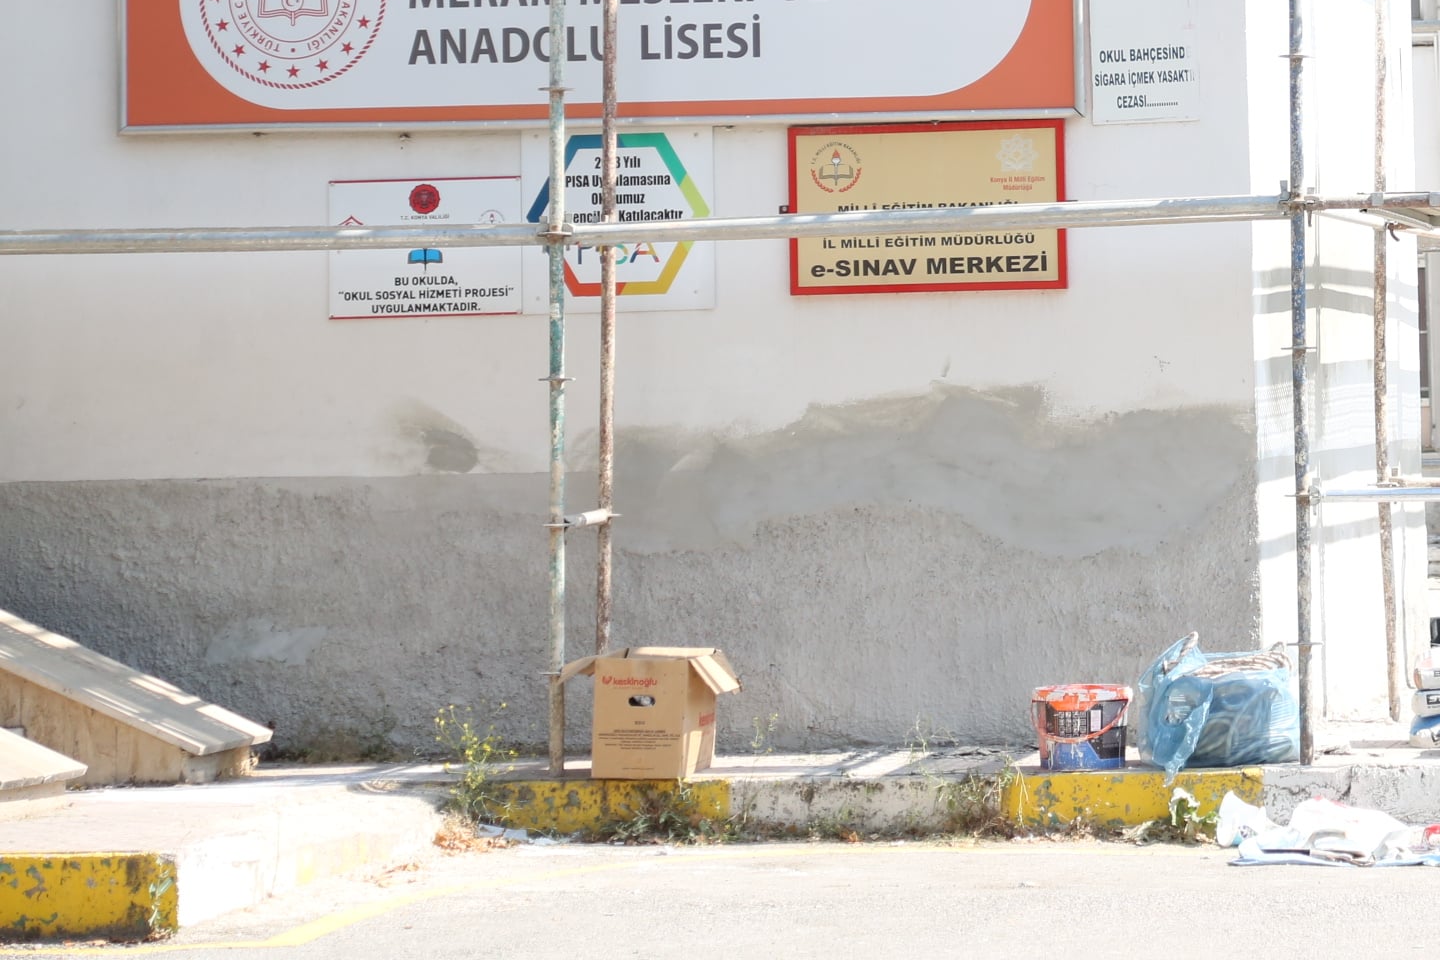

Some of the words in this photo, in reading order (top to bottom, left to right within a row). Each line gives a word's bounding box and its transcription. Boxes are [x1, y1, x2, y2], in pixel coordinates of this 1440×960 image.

[238, 12, 280, 53] TÜRKİYE
[640, 13, 761, 61] LİSESİ
[1099, 49, 1127, 64] OKUL
[1129, 43, 1191, 64] BAHÇESİND
[1094, 70, 1126, 87] SİGARA
[1128, 69, 1155, 88] İÇMEK
[1156, 69, 1195, 83] YASAKT
[623, 155, 641, 168] Yılı
[565, 174, 590, 188] PISA
[592, 173, 671, 188] Uylamasına
[591, 192, 645, 205] Oumuz
[618, 208, 683, 222] Katılacaktır
[823, 237, 836, 249] İL
[885, 235, 936, 248] EĞİTİM
[941, 232, 1035, 247] MÜDÜRLÜĞÜ
[810, 258, 918, 278] e-SINAV
[926, 251, 1048, 275] MERKEZİ
[394, 277, 409, 287] BU
[411, 276, 458, 287] OKULDA,
[375, 289, 416, 301] SOSYAL
[418, 286, 462, 299] HİZMETİ
[372, 302, 481, 313] UYGULANMAKTADIR.
